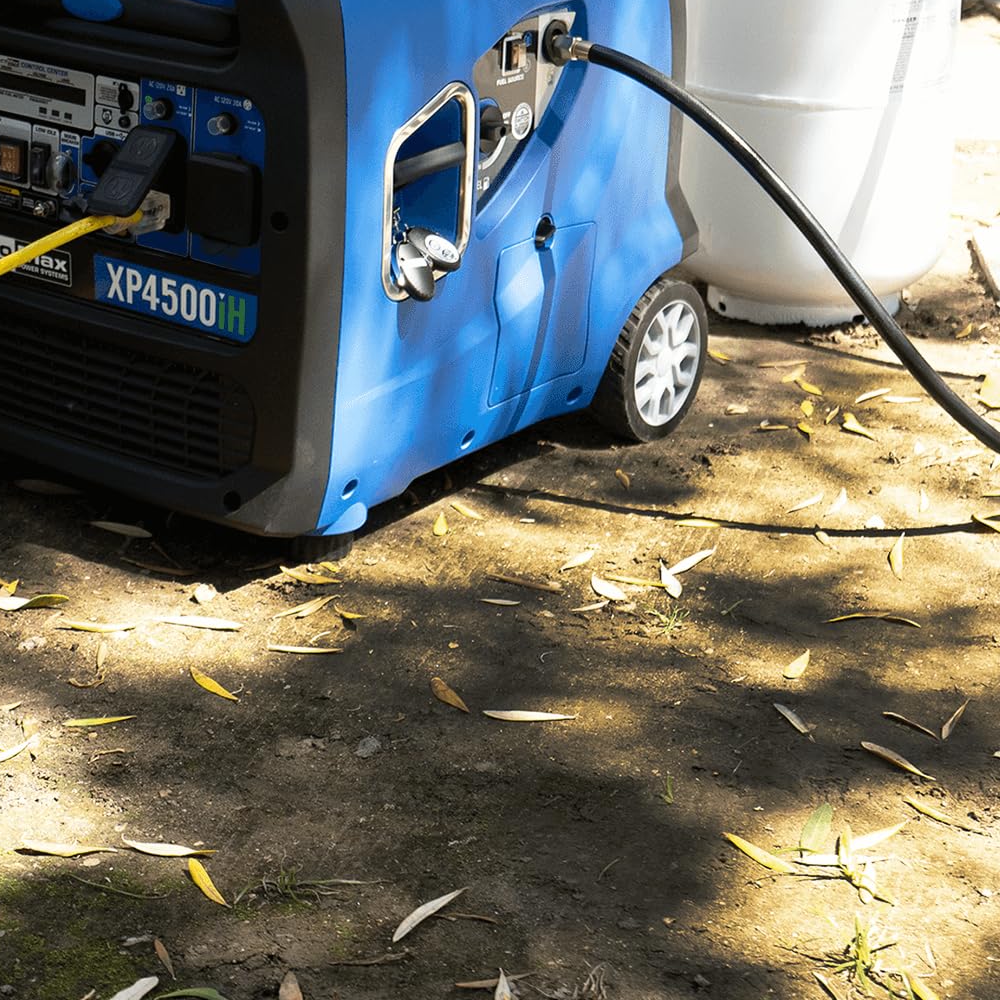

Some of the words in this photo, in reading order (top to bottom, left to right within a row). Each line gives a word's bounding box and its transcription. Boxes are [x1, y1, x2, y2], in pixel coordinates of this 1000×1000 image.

[18, 264, 40, 275] OWER
[40, 268, 69, 281] SYSTEMS
[106, 262, 246, 336] XP4500iH
